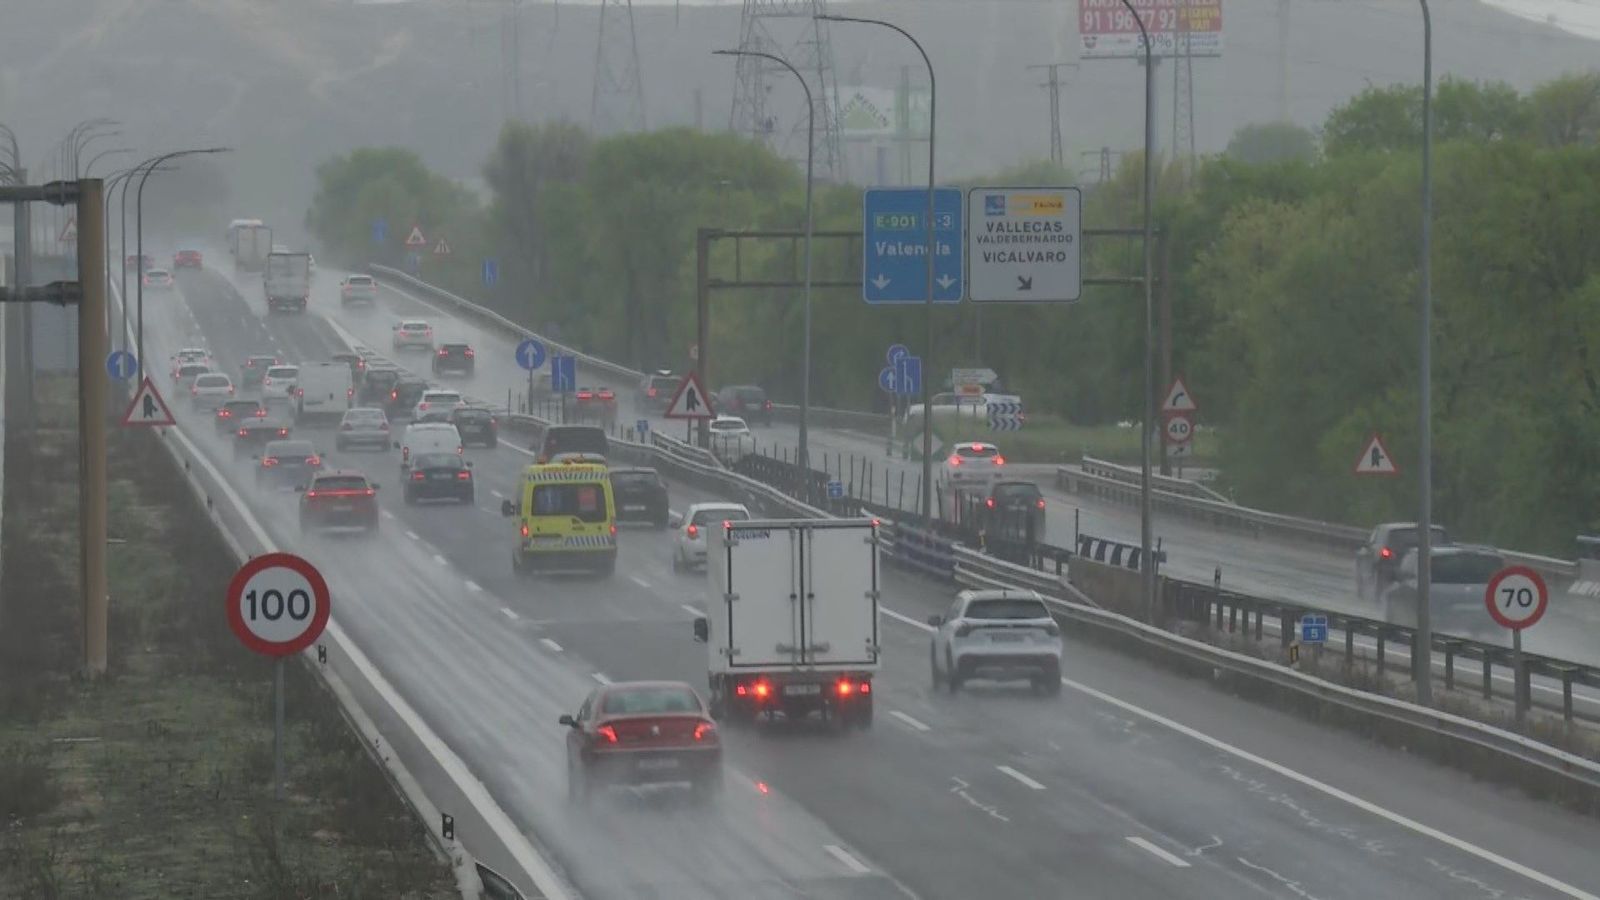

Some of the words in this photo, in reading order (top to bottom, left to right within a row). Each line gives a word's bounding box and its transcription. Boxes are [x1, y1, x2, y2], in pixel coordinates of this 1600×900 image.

[1084, 10, 1101, 30] 91
[1108, 10, 1133, 30] 196
[1159, 8, 1177, 29] 92
[876, 216, 916, 227] E-901
[986, 221, 1063, 233] VALLECAS
[976, 234, 1074, 243] VALDEBERNARDO
[983, 251, 1067, 263] VICALVARO
[1170, 423, 1188, 433] 40
[1502, 588, 1533, 608] 70
[246, 588, 310, 621] 100
